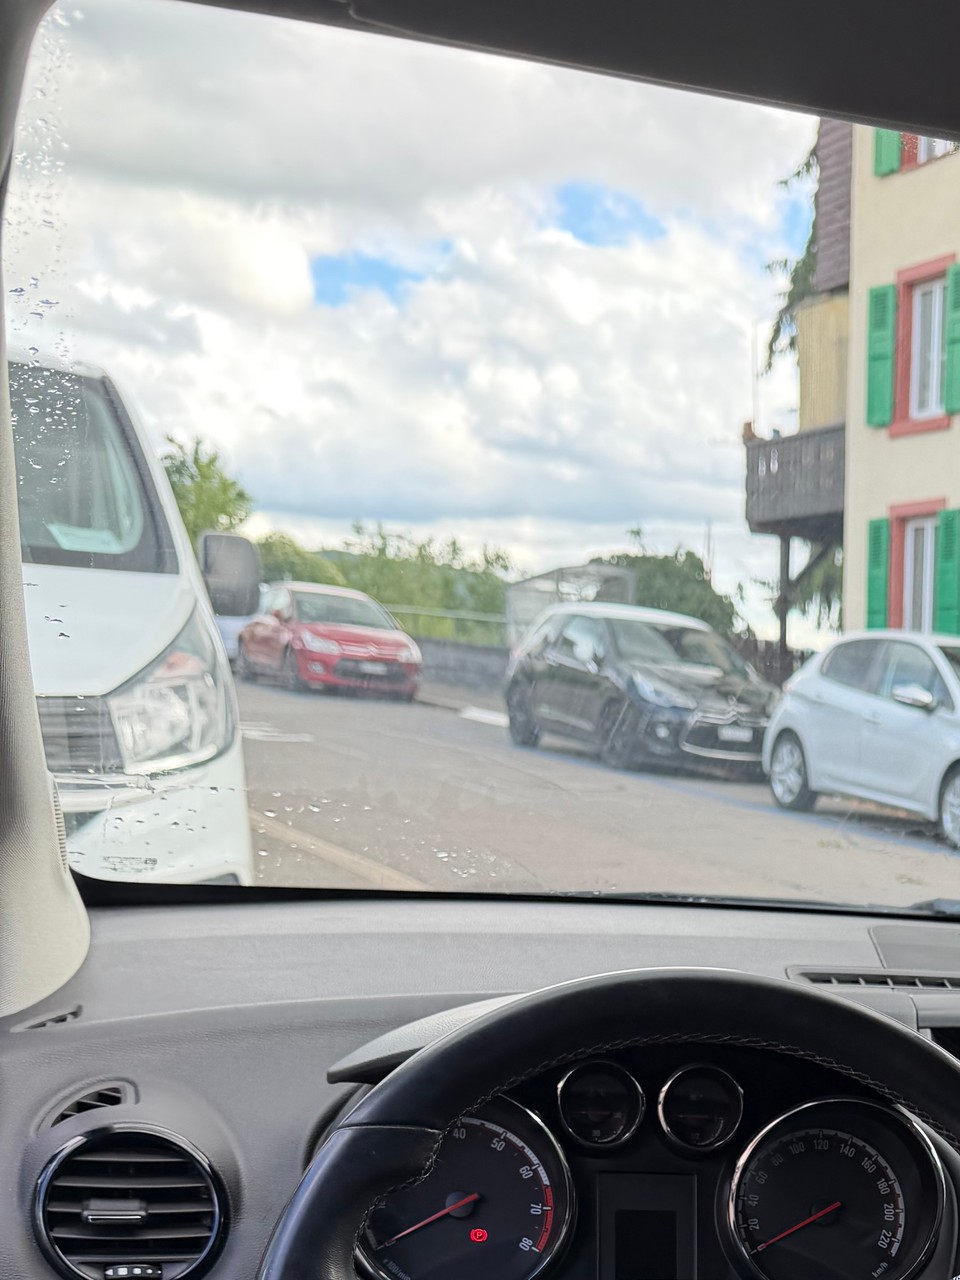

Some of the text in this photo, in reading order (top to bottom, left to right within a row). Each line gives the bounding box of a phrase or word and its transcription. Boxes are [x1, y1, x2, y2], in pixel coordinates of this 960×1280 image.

[453, 1127, 467, 1140] 40
[490, 1137, 506, 1152] 50
[813, 1139, 829, 1150] 120
[839, 1143, 856, 1158] 140
[518, 1165, 534, 1179] 60
[860, 1156, 877, 1173] 160
[876, 1178, 891, 1195] 180
[530, 1202, 543, 1215] 70
[883, 1203, 895, 1221] 200
[518, 1237, 534, 1252] 80
[877, 1229, 893, 1249] 220
[871, 1261, 889, 1279] km/h
